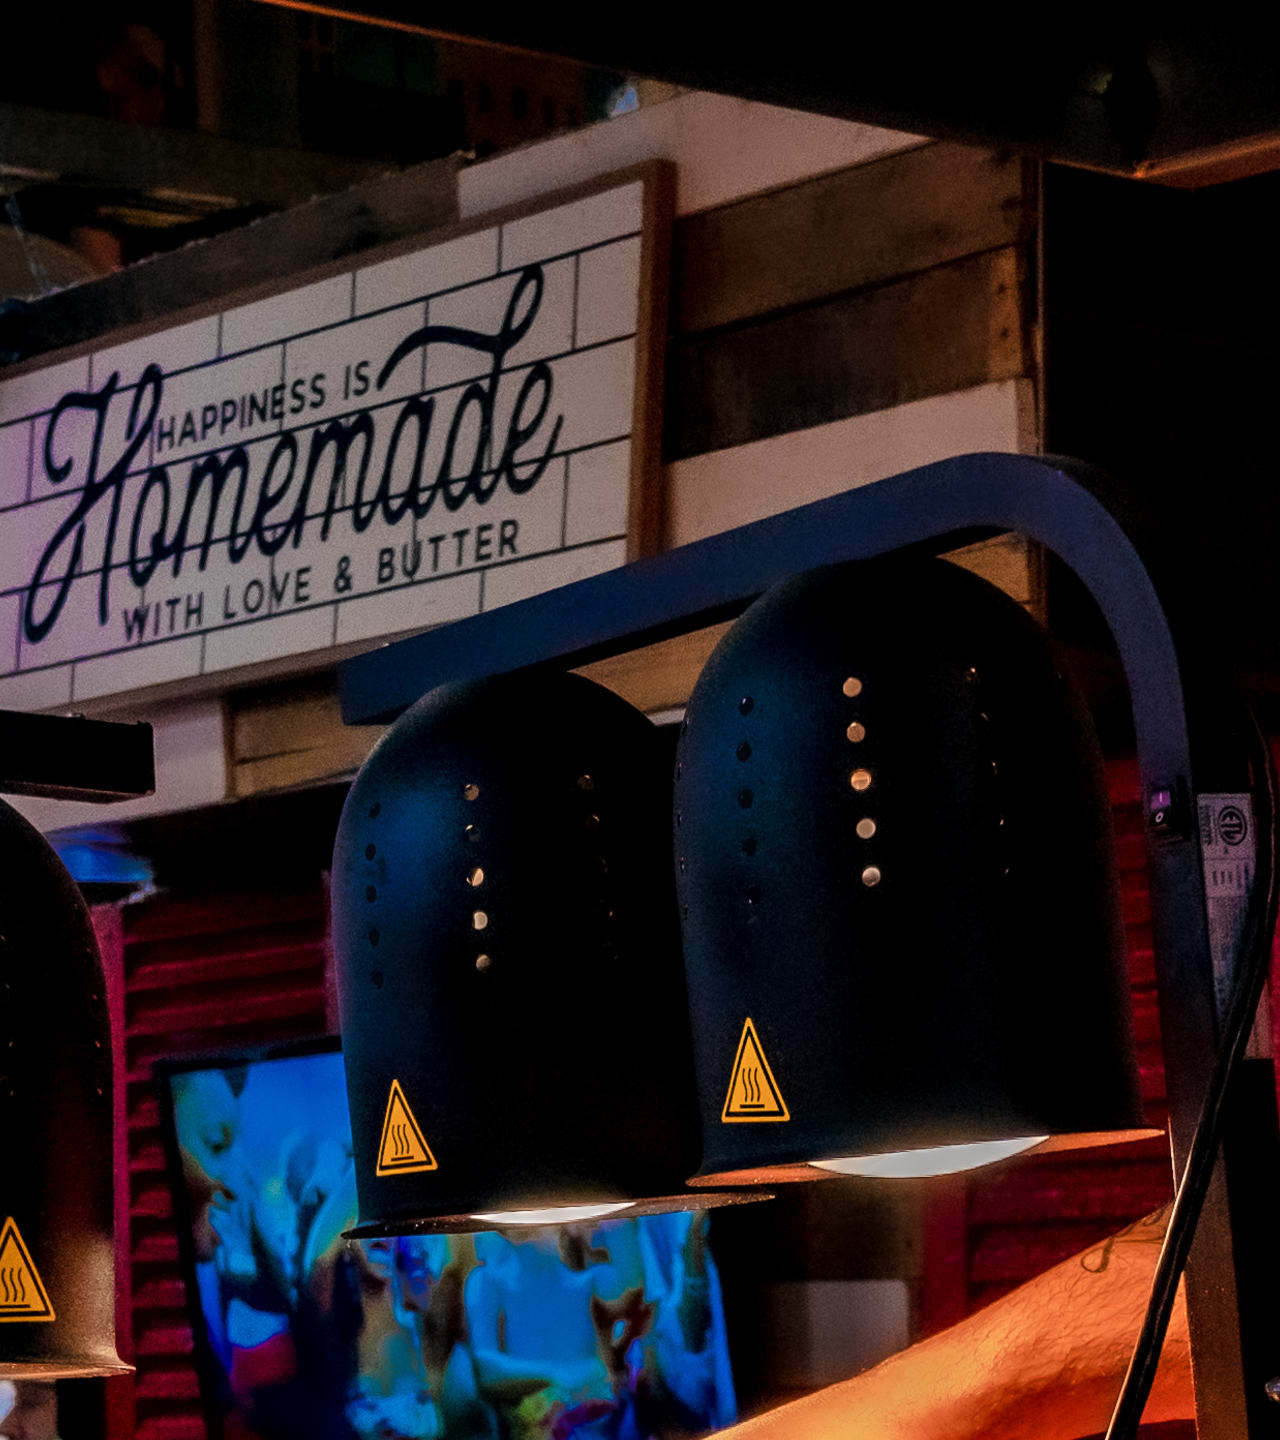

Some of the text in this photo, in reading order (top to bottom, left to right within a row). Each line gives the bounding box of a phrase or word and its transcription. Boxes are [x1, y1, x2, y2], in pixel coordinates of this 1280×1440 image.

[23, 263, 564, 643] Homemade
[156, 360, 372, 455] HAPPINESS IS
[123, 518, 521, 643] WITH LOVE & BUTTER
